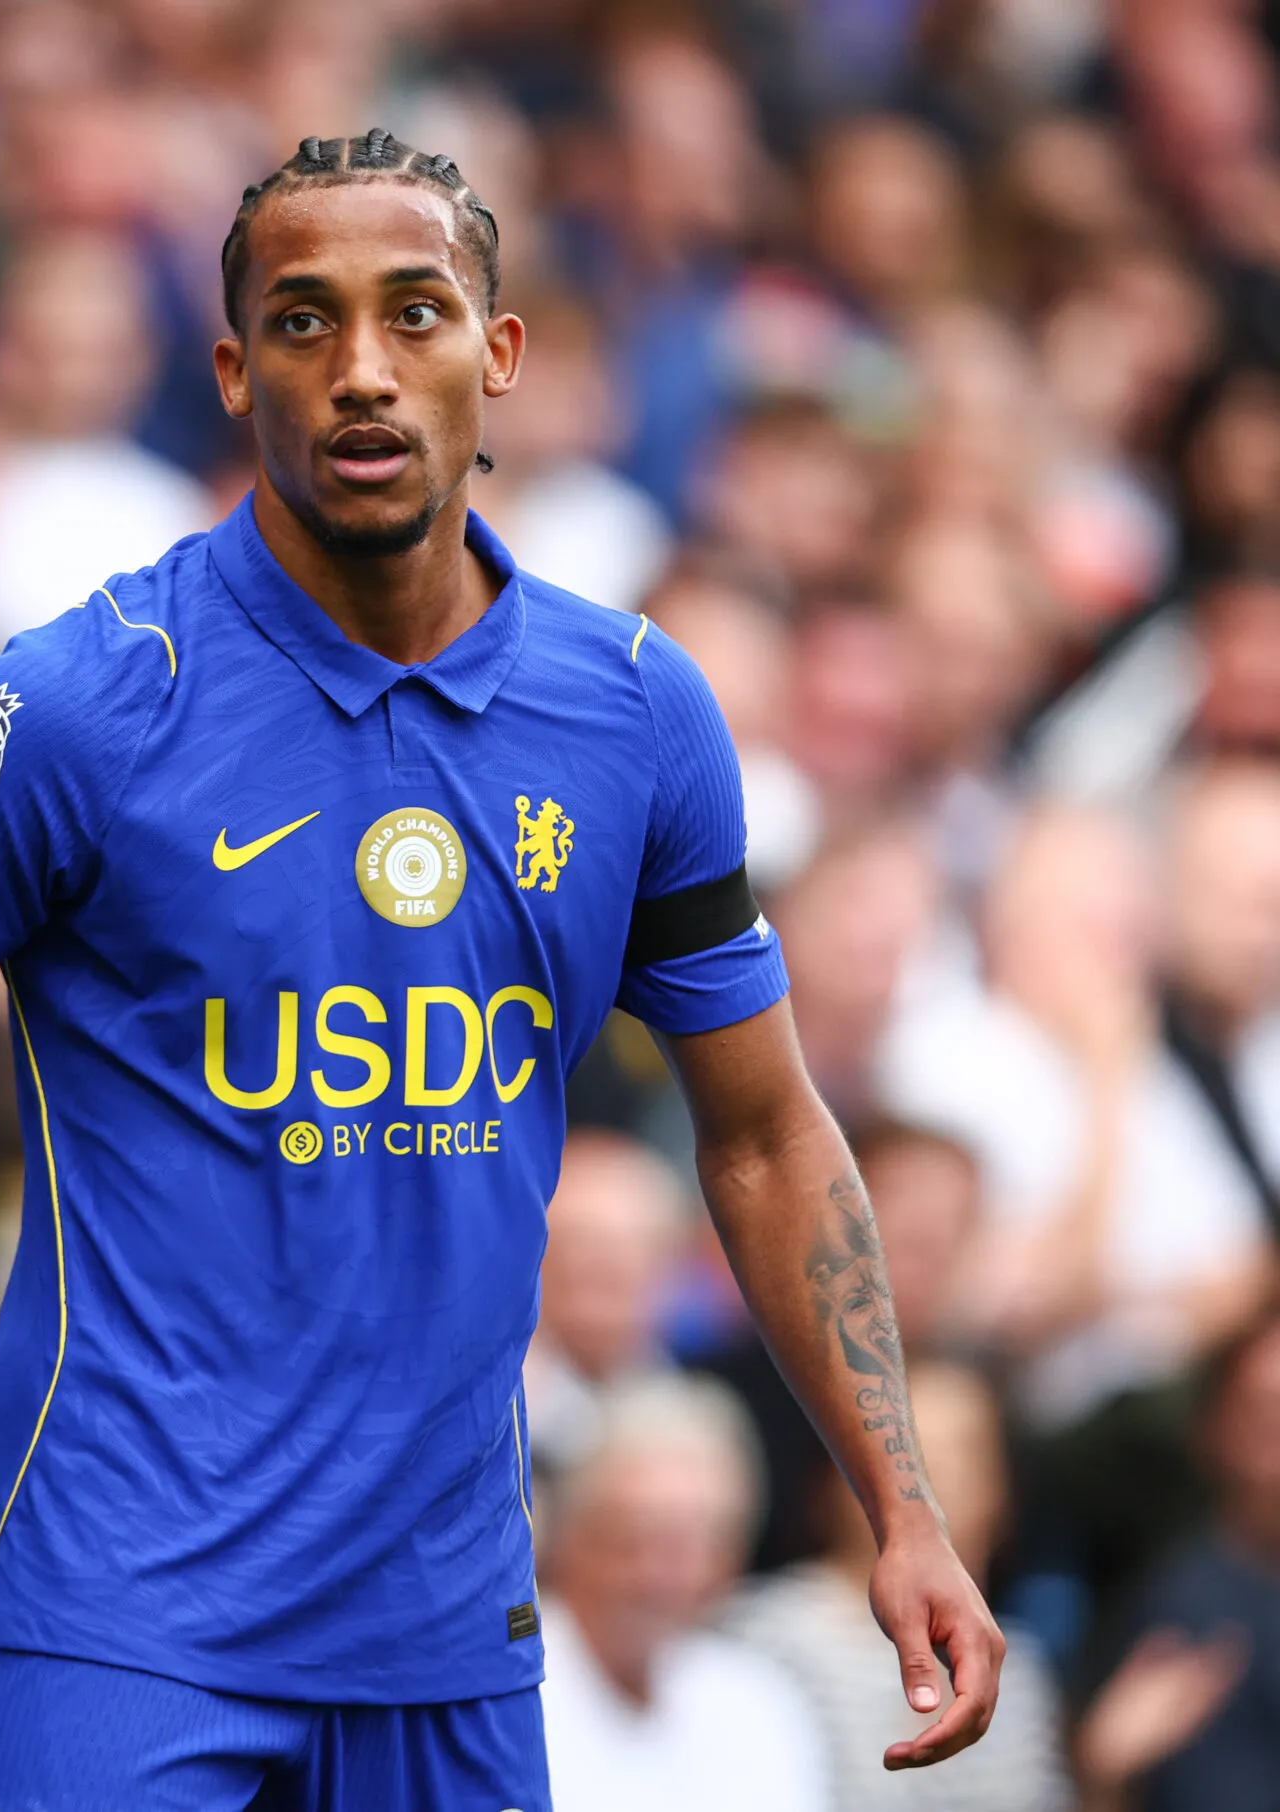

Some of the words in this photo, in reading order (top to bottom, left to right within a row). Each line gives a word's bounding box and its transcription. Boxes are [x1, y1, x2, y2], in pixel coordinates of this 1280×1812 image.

[367, 828, 394, 881] WORLD
[396, 819, 458, 880] CHAMPIONS
[395, 899, 437, 916] FIFA
[205, 985, 554, 1110] USDC
[333, 1123, 372, 1156] BY
[384, 1120, 501, 1155] CIRCLE
